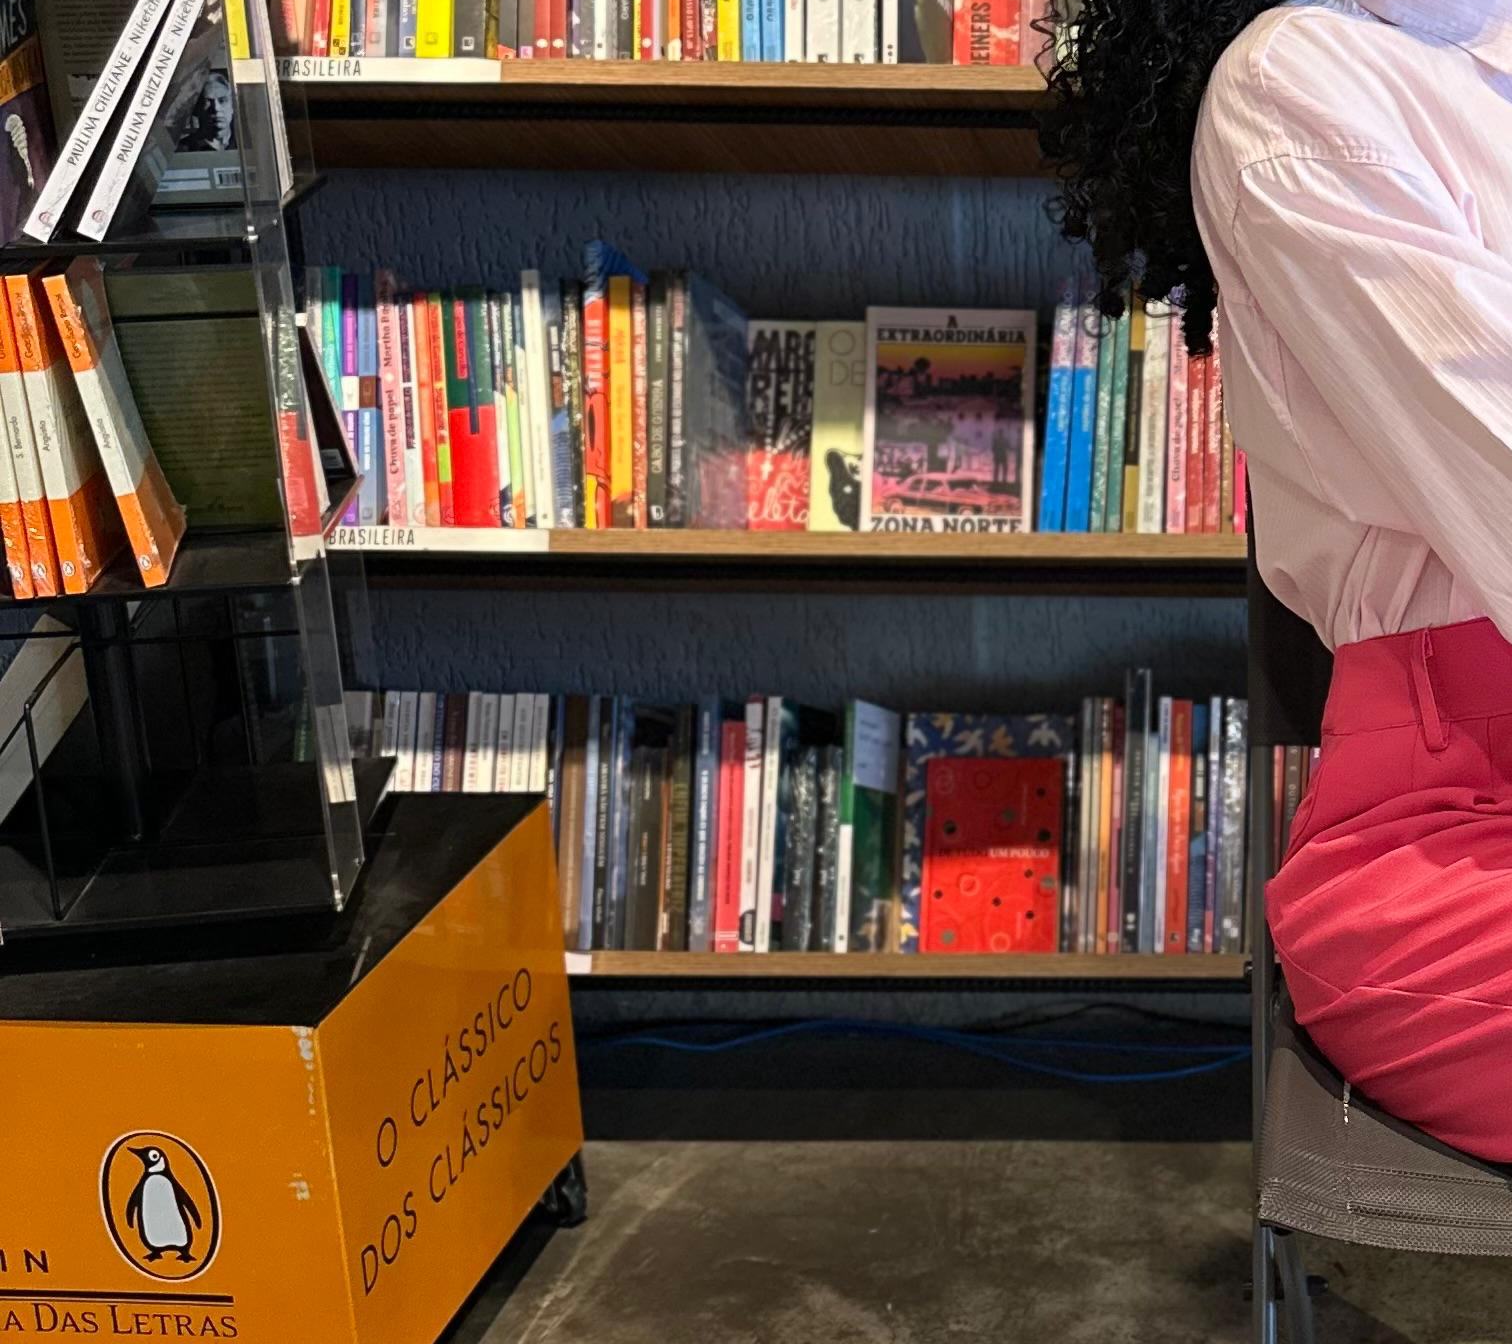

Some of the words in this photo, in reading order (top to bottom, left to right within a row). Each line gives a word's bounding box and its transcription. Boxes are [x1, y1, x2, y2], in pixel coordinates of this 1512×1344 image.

[67, 116, 100, 167] PAULINA
[95, 53, 132, 114] CHIZIANE
[117, 112, 147, 163] PAULINA
[142, 47, 175, 108] CHIZIANE
[877, 326, 1026, 344] EXTRAORDINÁRIA
[946, 315, 960, 328] A
[328, 529, 415, 546] BRASILEIRA
[871, 517, 936, 532] ZONA
[943, 517, 1024, 532] NORTE
[376, 1117, 398, 1168] O
[410, 967, 532, 1127] CLÁSSICO
[360, 1191, 417, 1296] DOS
[428, 1021, 562, 1203] CLÁSSICOS
[33, 1303, 99, 1334] DAS
[109, 1304, 239, 1339] LETRAS
